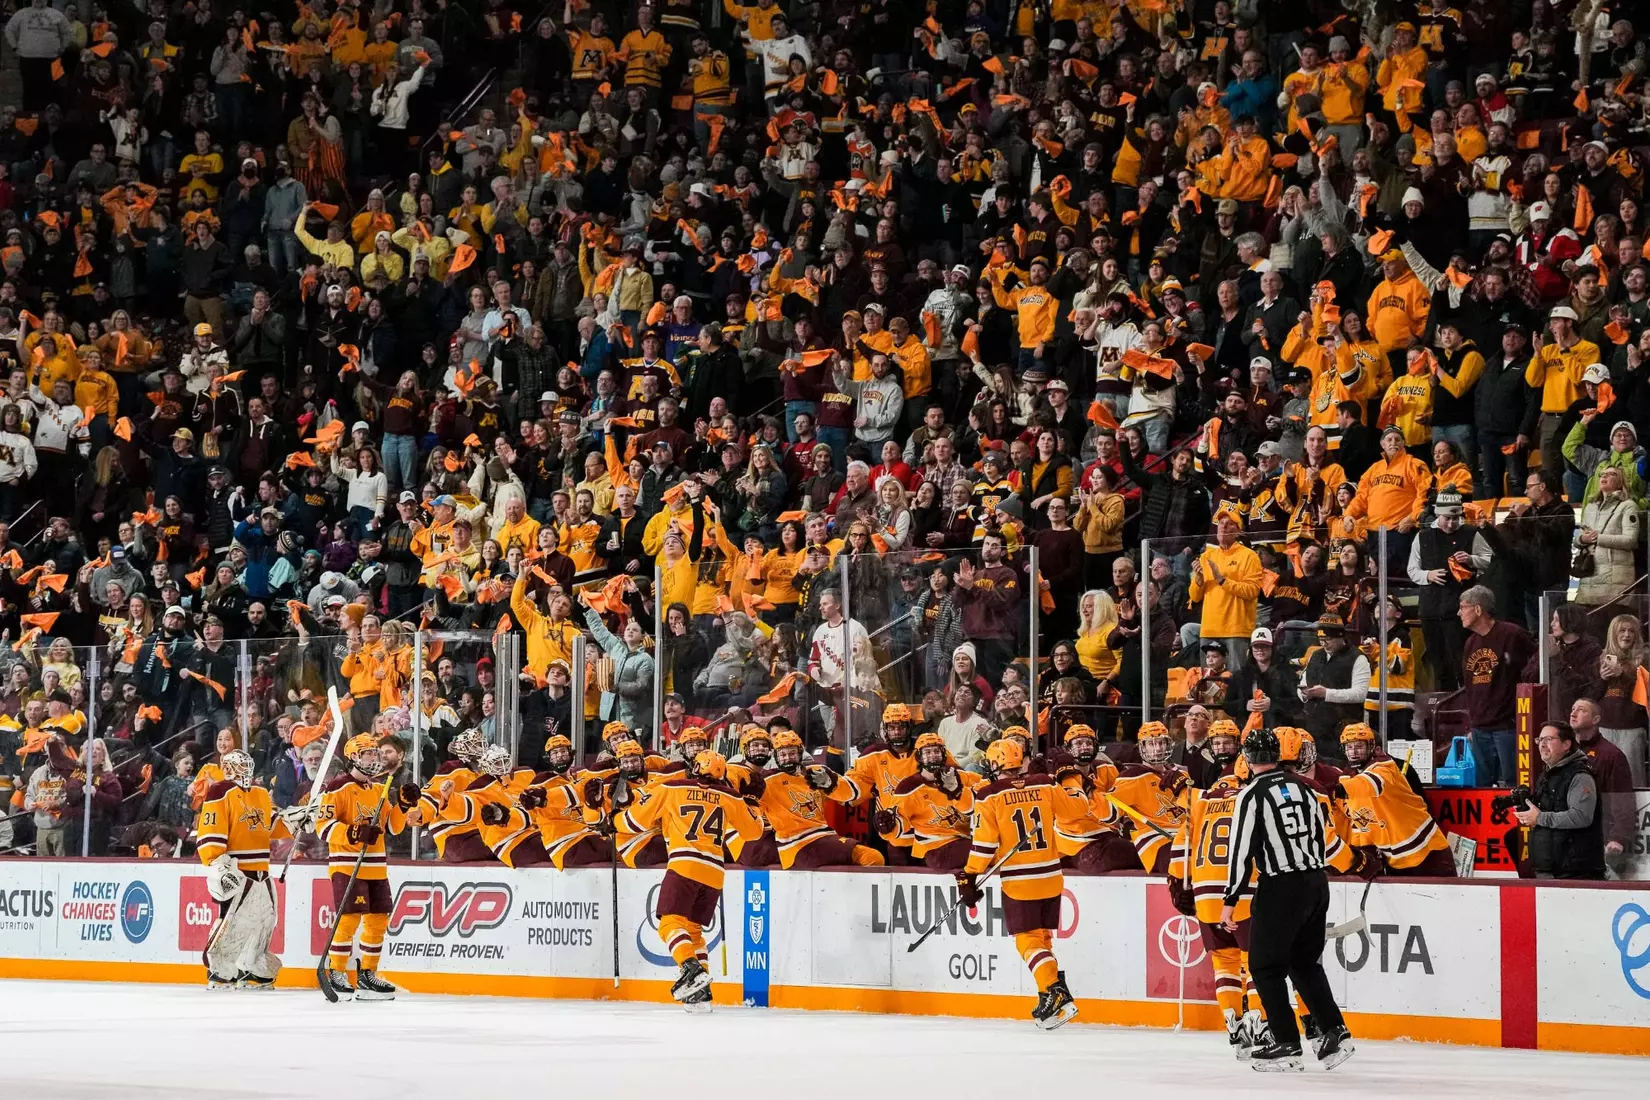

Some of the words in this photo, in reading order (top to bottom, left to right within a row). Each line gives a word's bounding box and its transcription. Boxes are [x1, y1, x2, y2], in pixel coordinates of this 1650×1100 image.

[1517, 698, 1531, 861] MINNETA
[687, 790, 720, 804] ZIEMER
[1004, 789, 1042, 805] LUDTKE
[203, 812, 217, 825] 31
[680, 804, 724, 847] 74
[1280, 804, 1308, 835] 51
[1011, 806, 1048, 852] 11
[1196, 817, 1233, 869] 18
[73, 882, 120, 899] HOCKEY
[62, 902, 116, 920] CHANGES
[186, 902, 212, 926] Cub
[318, 905, 338, 929] Cu
[388, 883, 511, 936] FVP
[522, 901, 600, 920] AUTOMOTIVE
[81, 924, 112, 941] LIVES
[528, 928, 592, 946] PRODUCTS
[388, 943, 445, 957] VERIFIED.
[450, 944, 505, 959] PROVEN.
[746, 952, 766, 969] MN
[949, 953, 998, 981] GOLF
